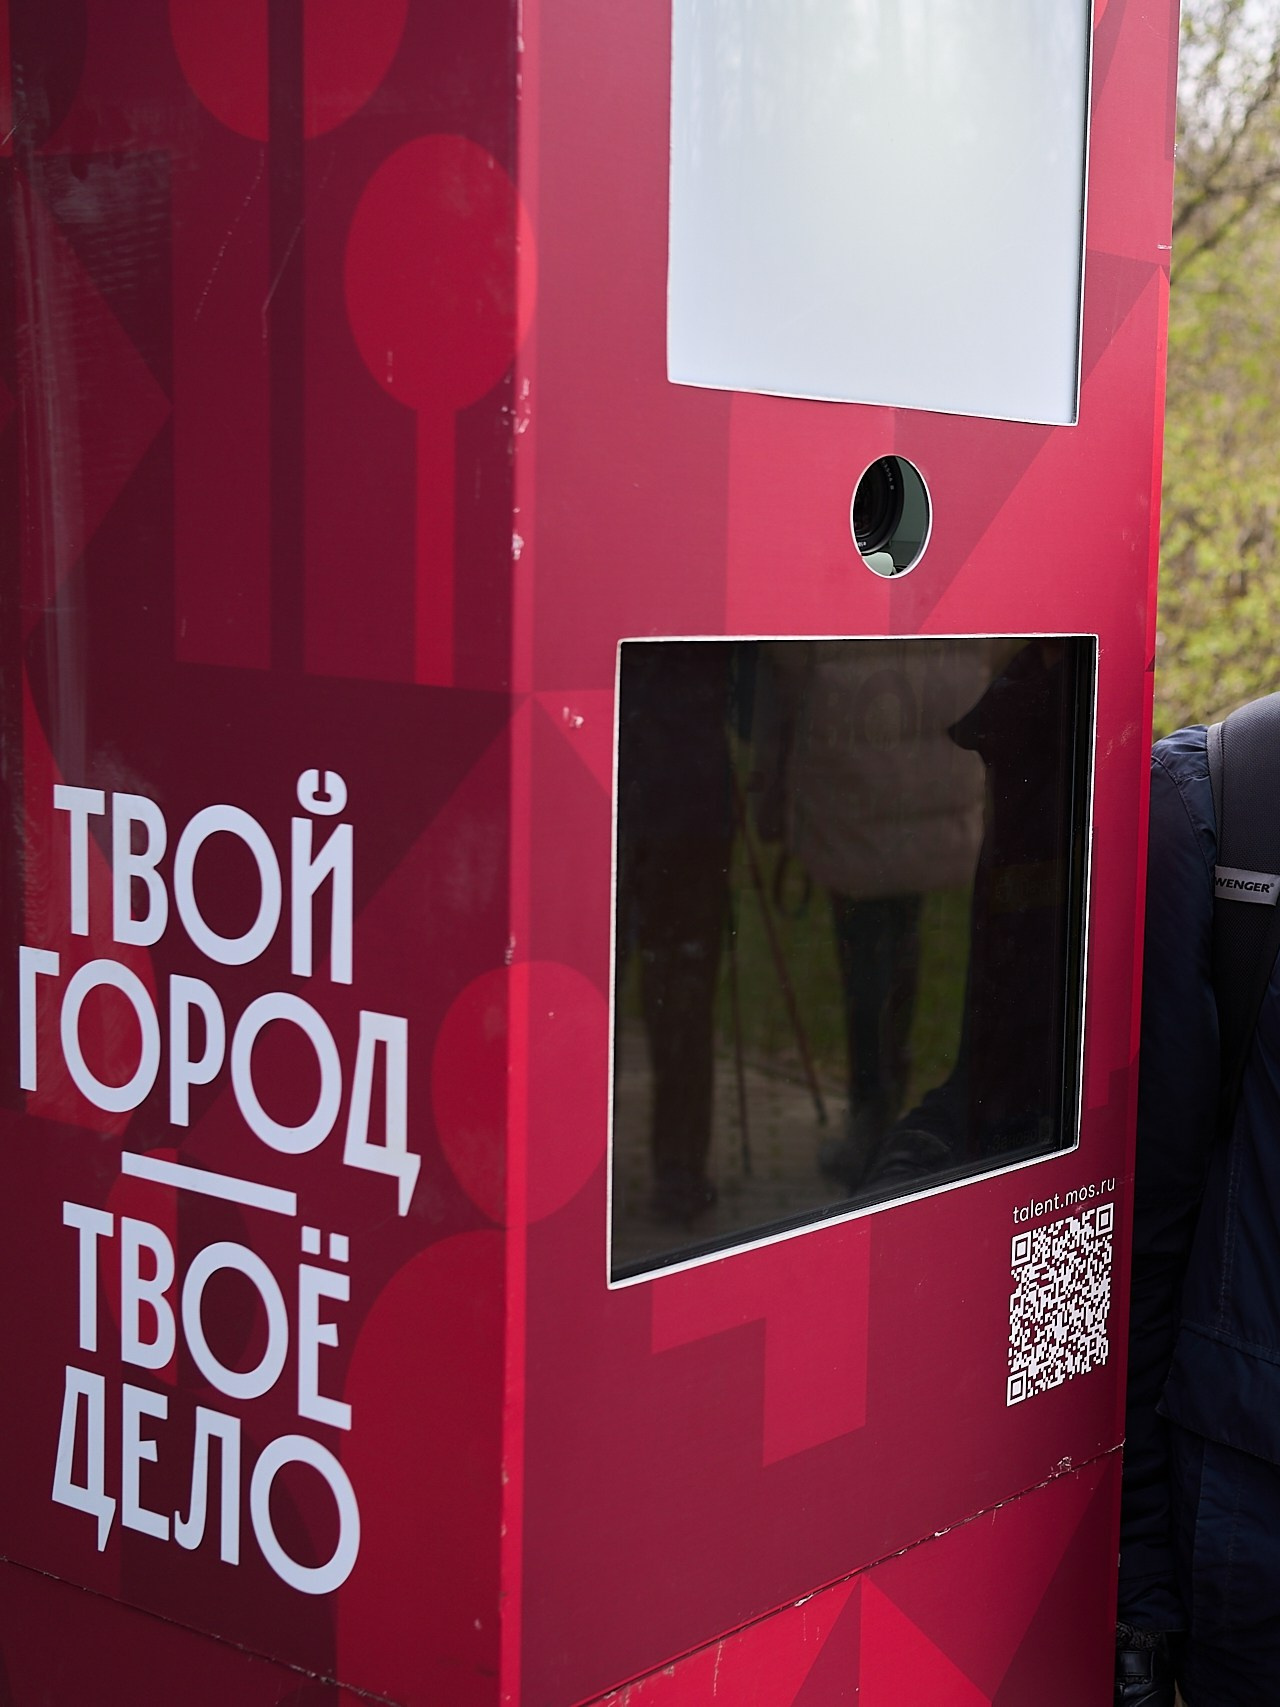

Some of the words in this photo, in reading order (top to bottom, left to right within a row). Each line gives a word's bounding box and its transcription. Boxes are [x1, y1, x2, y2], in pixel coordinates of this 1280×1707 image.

[53, 768, 354, 985] ТВОЙ
[18, 945, 422, 1217] ГОРОД
[62, 1200, 353, 1431] ТВОЁ
[1012, 1177, 1116, 1224] talent.mos.ru
[51, 1364, 361, 1595] ДЕЛО
